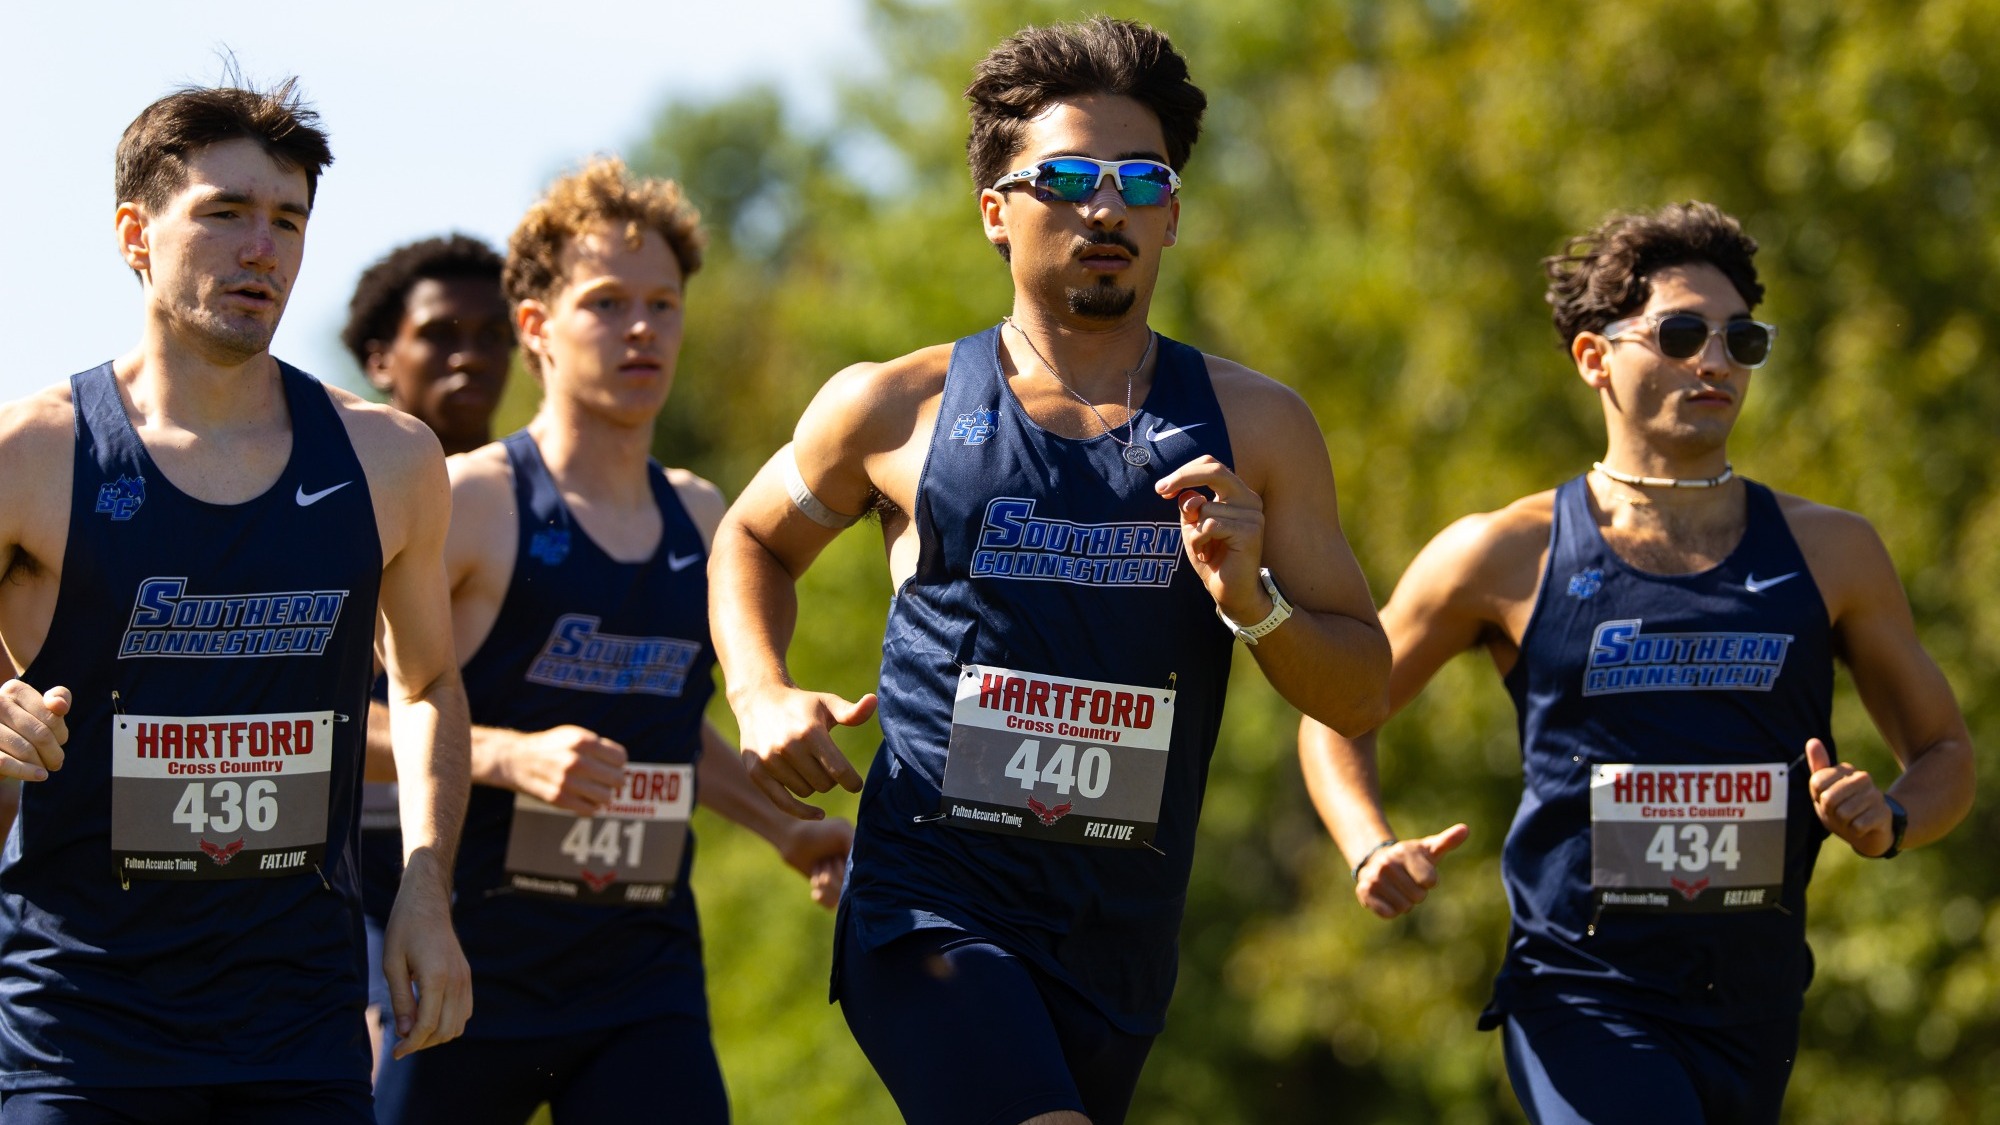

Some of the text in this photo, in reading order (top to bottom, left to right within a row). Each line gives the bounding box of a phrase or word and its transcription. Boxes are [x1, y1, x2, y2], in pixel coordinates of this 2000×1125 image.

[982, 501, 1183, 556] SOUTHERN
[973, 550, 1176, 585] CONNECTICUT
[131, 579, 341, 628] SOUTHERN
[121, 627, 332, 656] CONNECTICUT
[1592, 624, 1784, 667] SOUTHERN
[1586, 664, 1778, 692] CONNECTICUT
[979, 673, 1155, 730] HARTFORD
[135, 720, 314, 759] HARTFORD
[1006, 715, 1121, 743] Cross Country
[168, 760, 283, 775] Cross Country
[1004, 738, 1112, 799] 440
[1614, 771, 1772, 804] HARTFORD
[172, 779, 279, 833] 436
[951, 804, 1023, 828] Fulton Accurate Timing
[1641, 806, 1746, 818] Cross Country
[561, 819, 645, 868] 441
[1084, 821, 1135, 841] FAT.LIVE
[1645, 823, 1742, 872] 434
[125, 857, 197, 872] Fulton Accurate Timing
[259, 851, 307, 870] FAT.LIVE
